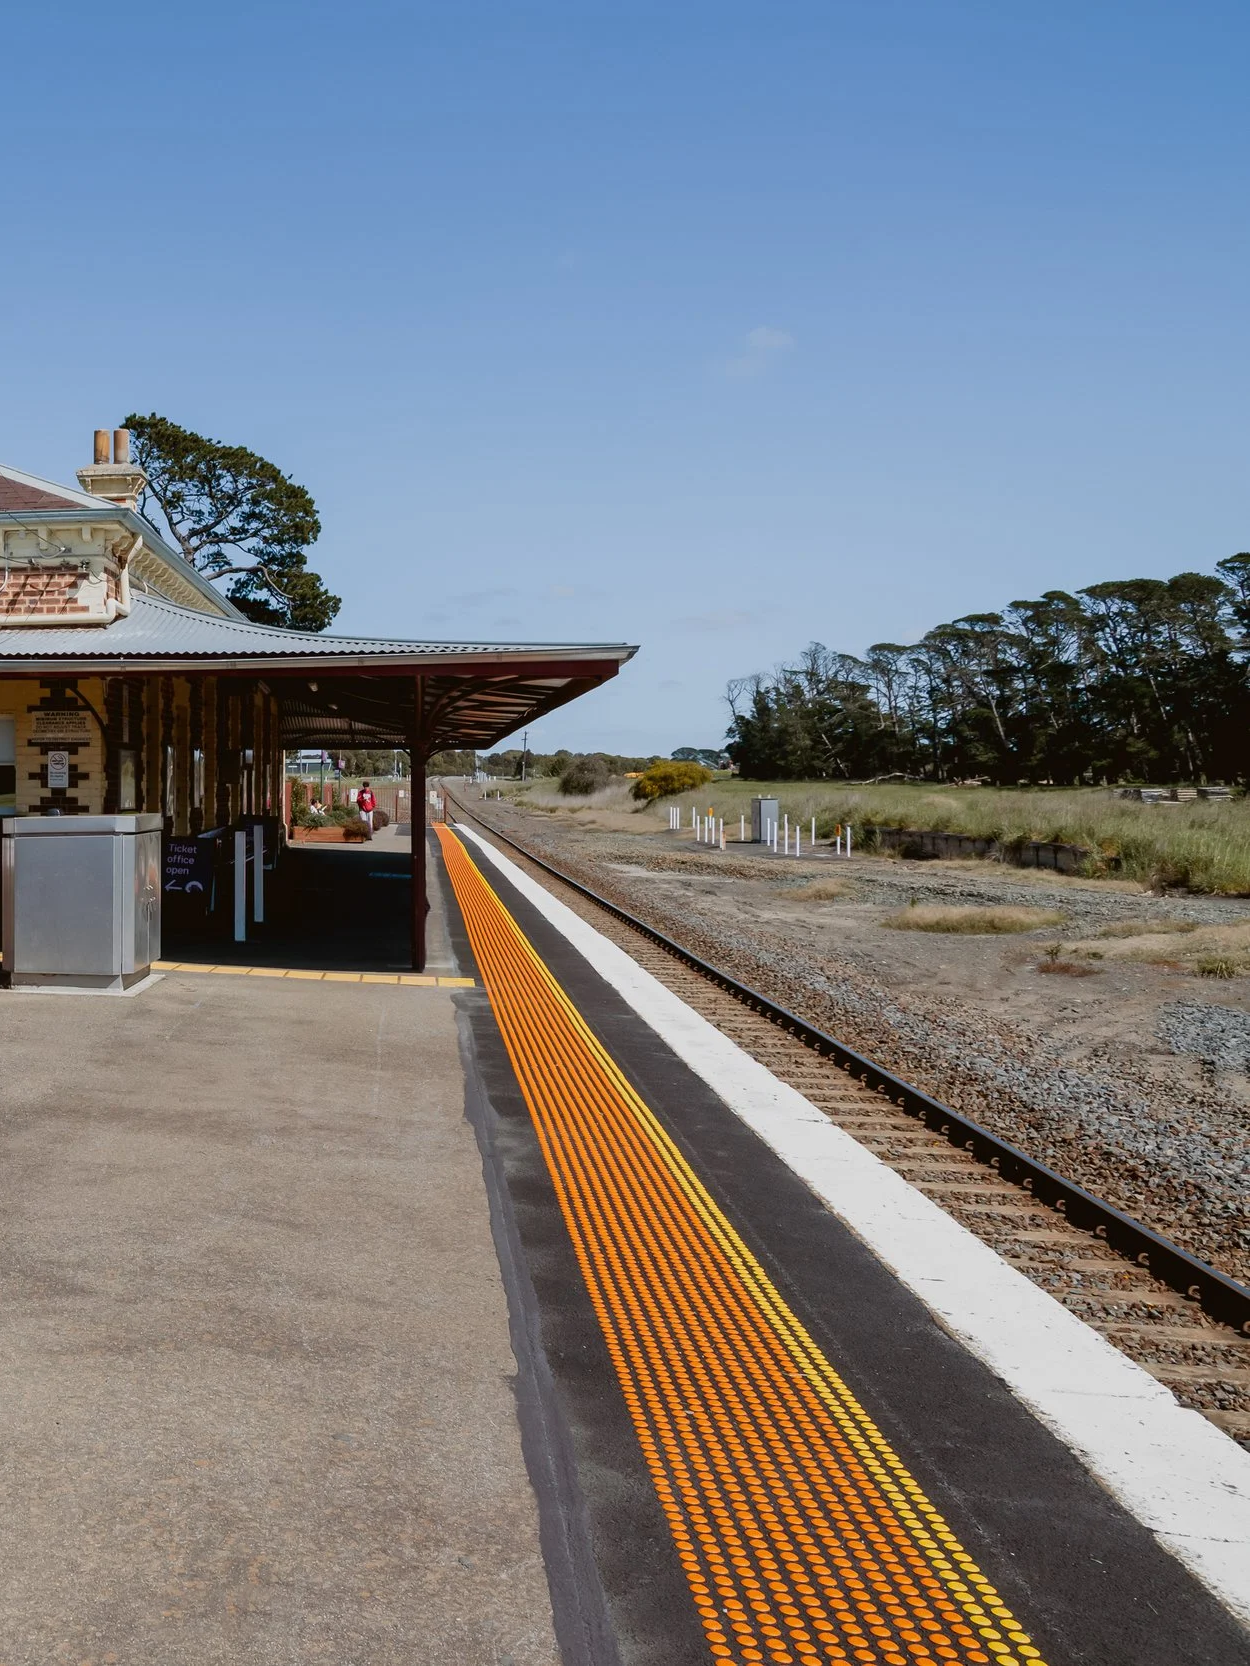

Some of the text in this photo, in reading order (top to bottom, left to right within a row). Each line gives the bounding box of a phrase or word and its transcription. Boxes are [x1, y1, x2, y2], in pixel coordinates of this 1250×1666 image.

[169, 844, 197, 854] Ticket
[167, 854, 195, 865] office
[166, 866, 189, 876] open
